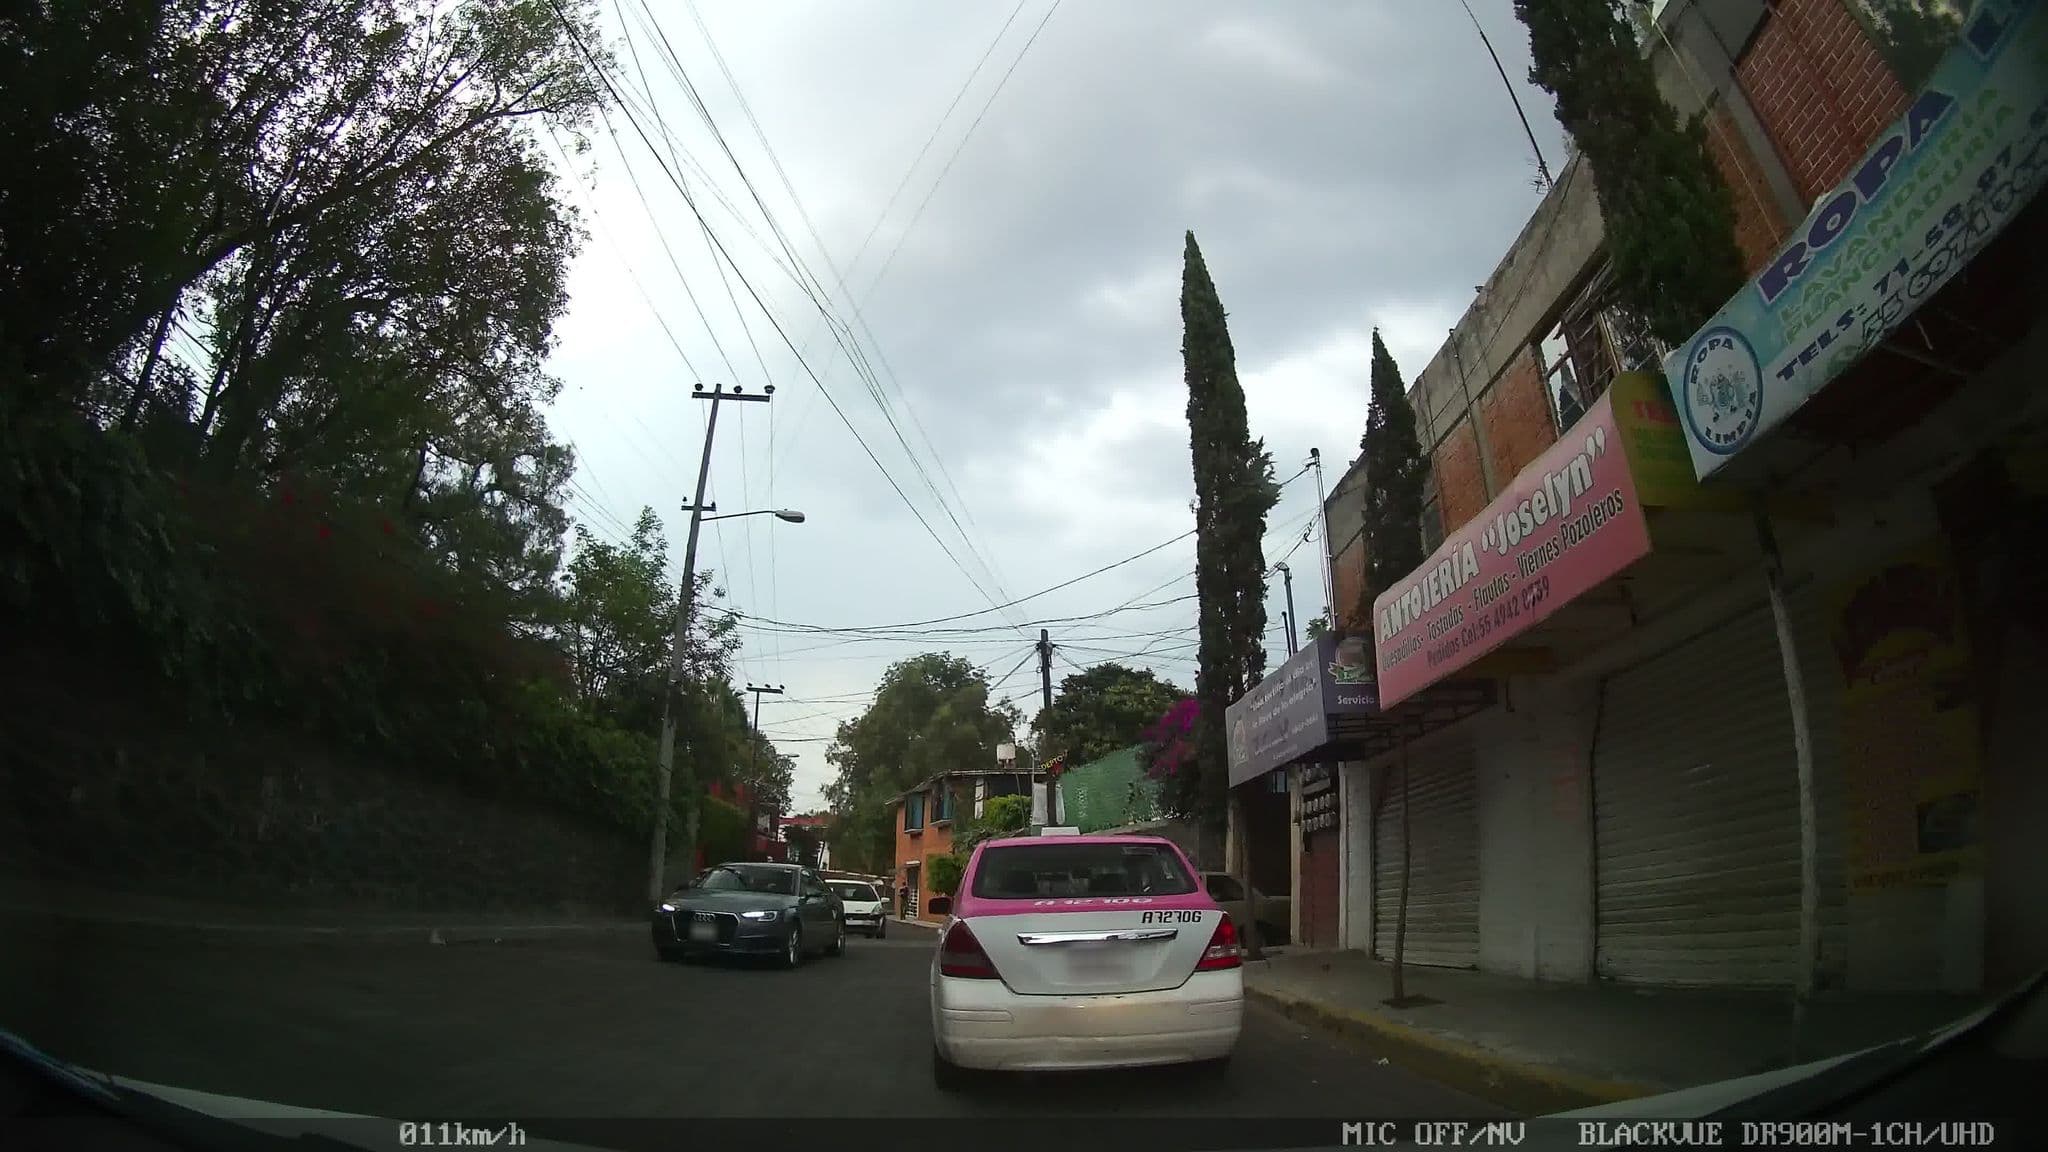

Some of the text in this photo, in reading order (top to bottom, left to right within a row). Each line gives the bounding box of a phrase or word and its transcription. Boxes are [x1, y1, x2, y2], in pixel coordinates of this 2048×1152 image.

[1757, 90, 1955, 302] ROPA
[1786, 105, 2015, 344] PLANCHADURIA
[1691, 338, 1734, 384] ROPA
[1776, 302, 1867, 381] TELS:
[1705, 391, 1756, 444] LIMPIA
[1380, 541, 1480, 645] ANTOJERÍA
[1426, 604, 1464, 641] Tostadas
[1473, 573, 1510, 612] Flautas
[1516, 537, 1560, 580] Viernes
[1560, 488, 1624, 551] Pozoleros
[1337, 695, 1375, 705] Servicio
